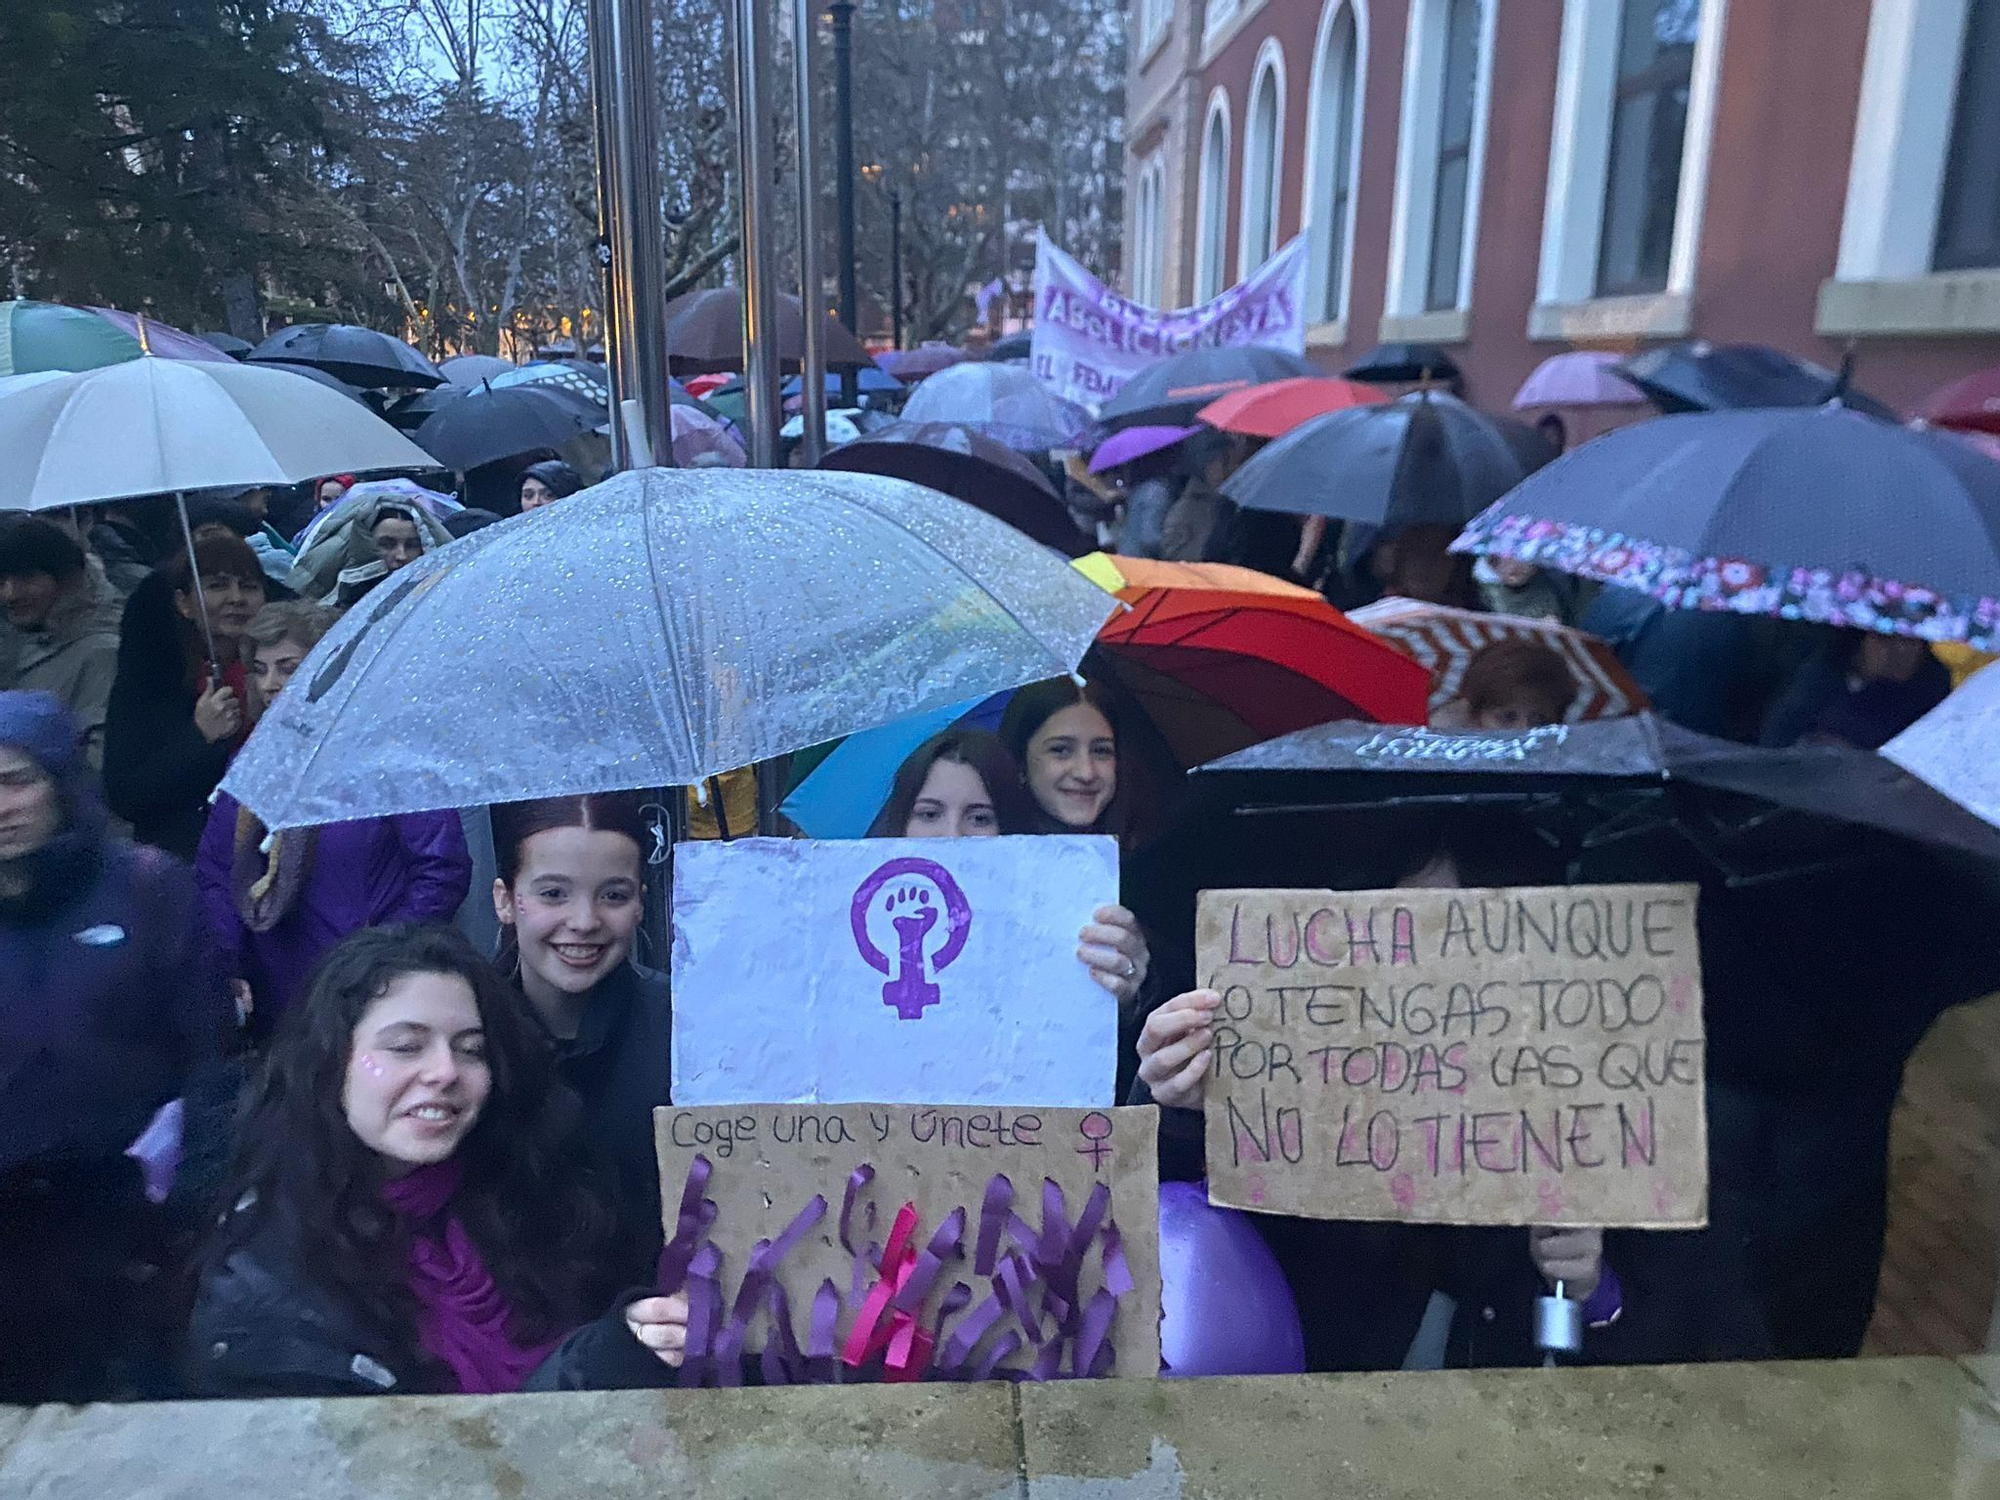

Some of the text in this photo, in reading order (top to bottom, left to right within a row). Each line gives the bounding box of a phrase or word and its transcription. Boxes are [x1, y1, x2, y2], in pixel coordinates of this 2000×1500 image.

[1229, 898, 1684, 968] LUCHA AUNQUE
[1266, 982, 1510, 1036] TENGAS
[1521, 973, 1666, 1031] TODO
[1213, 1026, 1302, 1083] POR
[1309, 1041, 1469, 1095] TODAS
[1599, 1037, 1707, 1092] QUE
[672, 1111, 757, 1158] Coge
[1226, 1087, 1657, 1177] NO LO TIENEN
